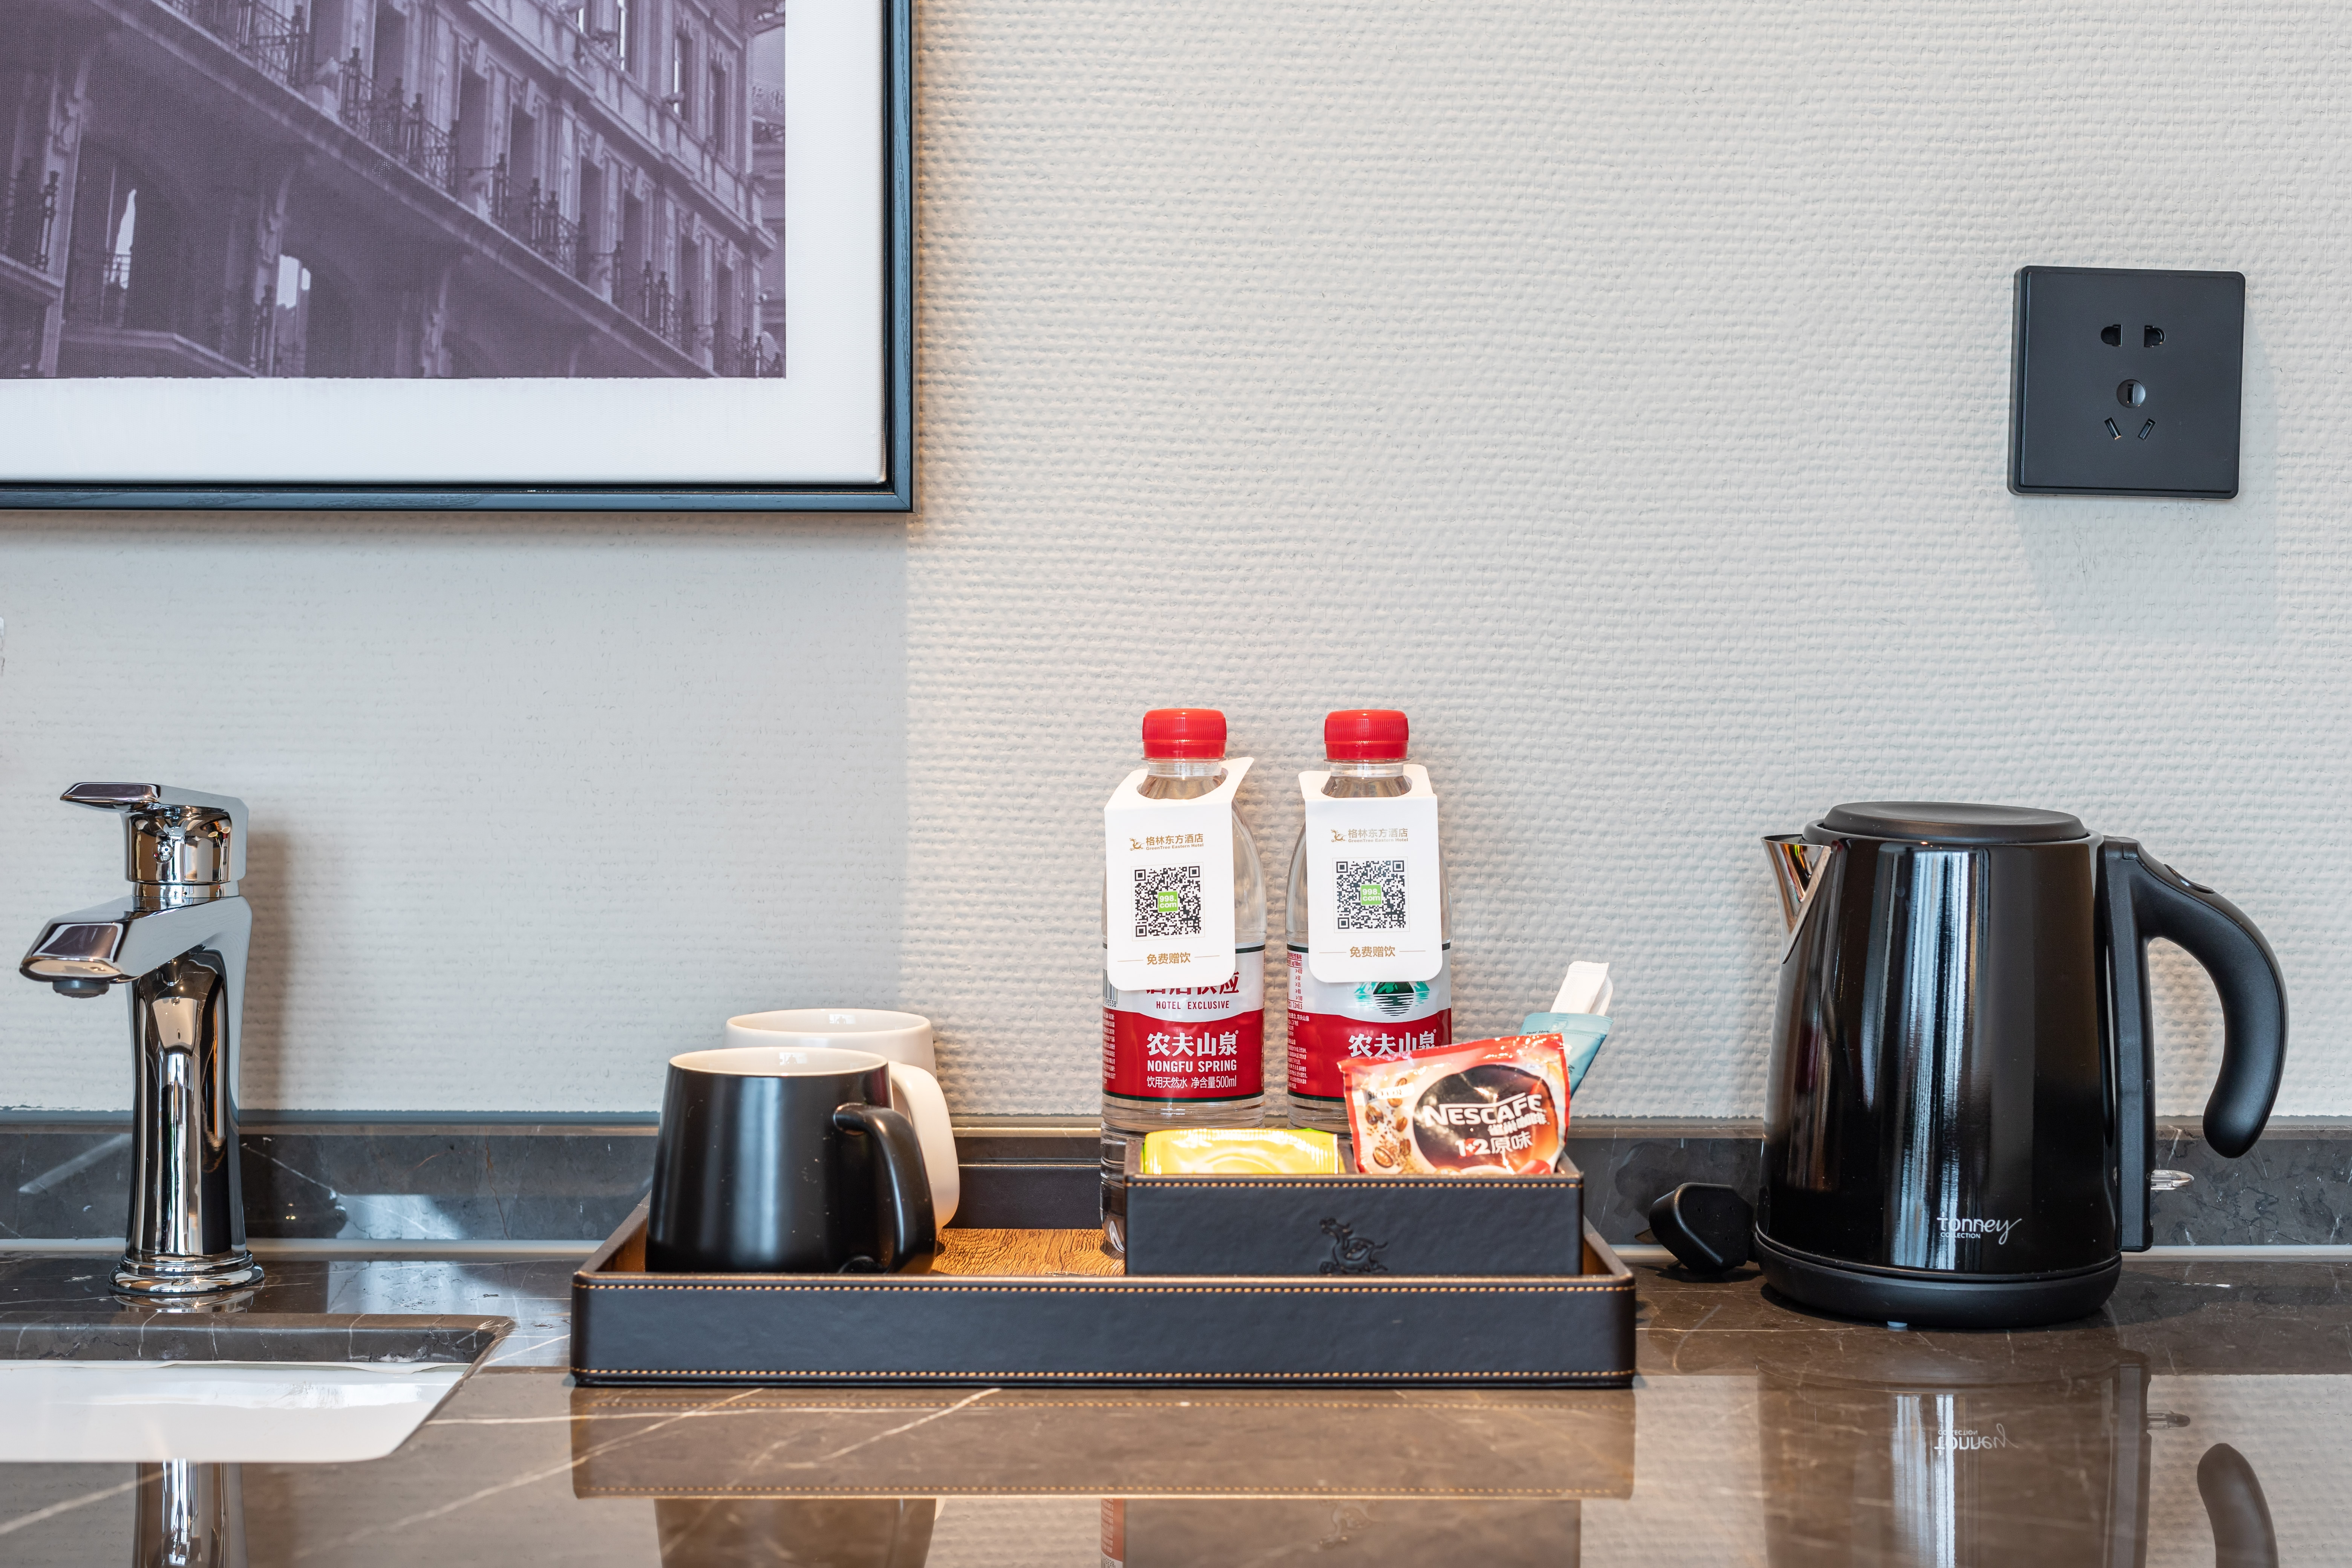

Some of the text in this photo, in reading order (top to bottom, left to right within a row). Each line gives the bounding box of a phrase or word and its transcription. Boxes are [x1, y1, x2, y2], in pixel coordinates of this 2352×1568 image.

[1146, 833, 1204, 846] 格林东方酒店
[1348, 828, 1408, 838] 格林东方酒店
[1349, 946, 1396, 957] 免费赠饮
[1147, 952, 1191, 965] 免费赠饮
[1156, 1000, 1230, 1009] HOTEL EXCLUSIVE
[1147, 1031, 1237, 1057] 农夫山泉
[1348, 1031, 1435, 1058] 农夫山泉
[1147, 1060, 1237, 1072] NONGFU SPRING
[1147, 1075, 1237, 1089] 饮用天然水 净含量500ml
